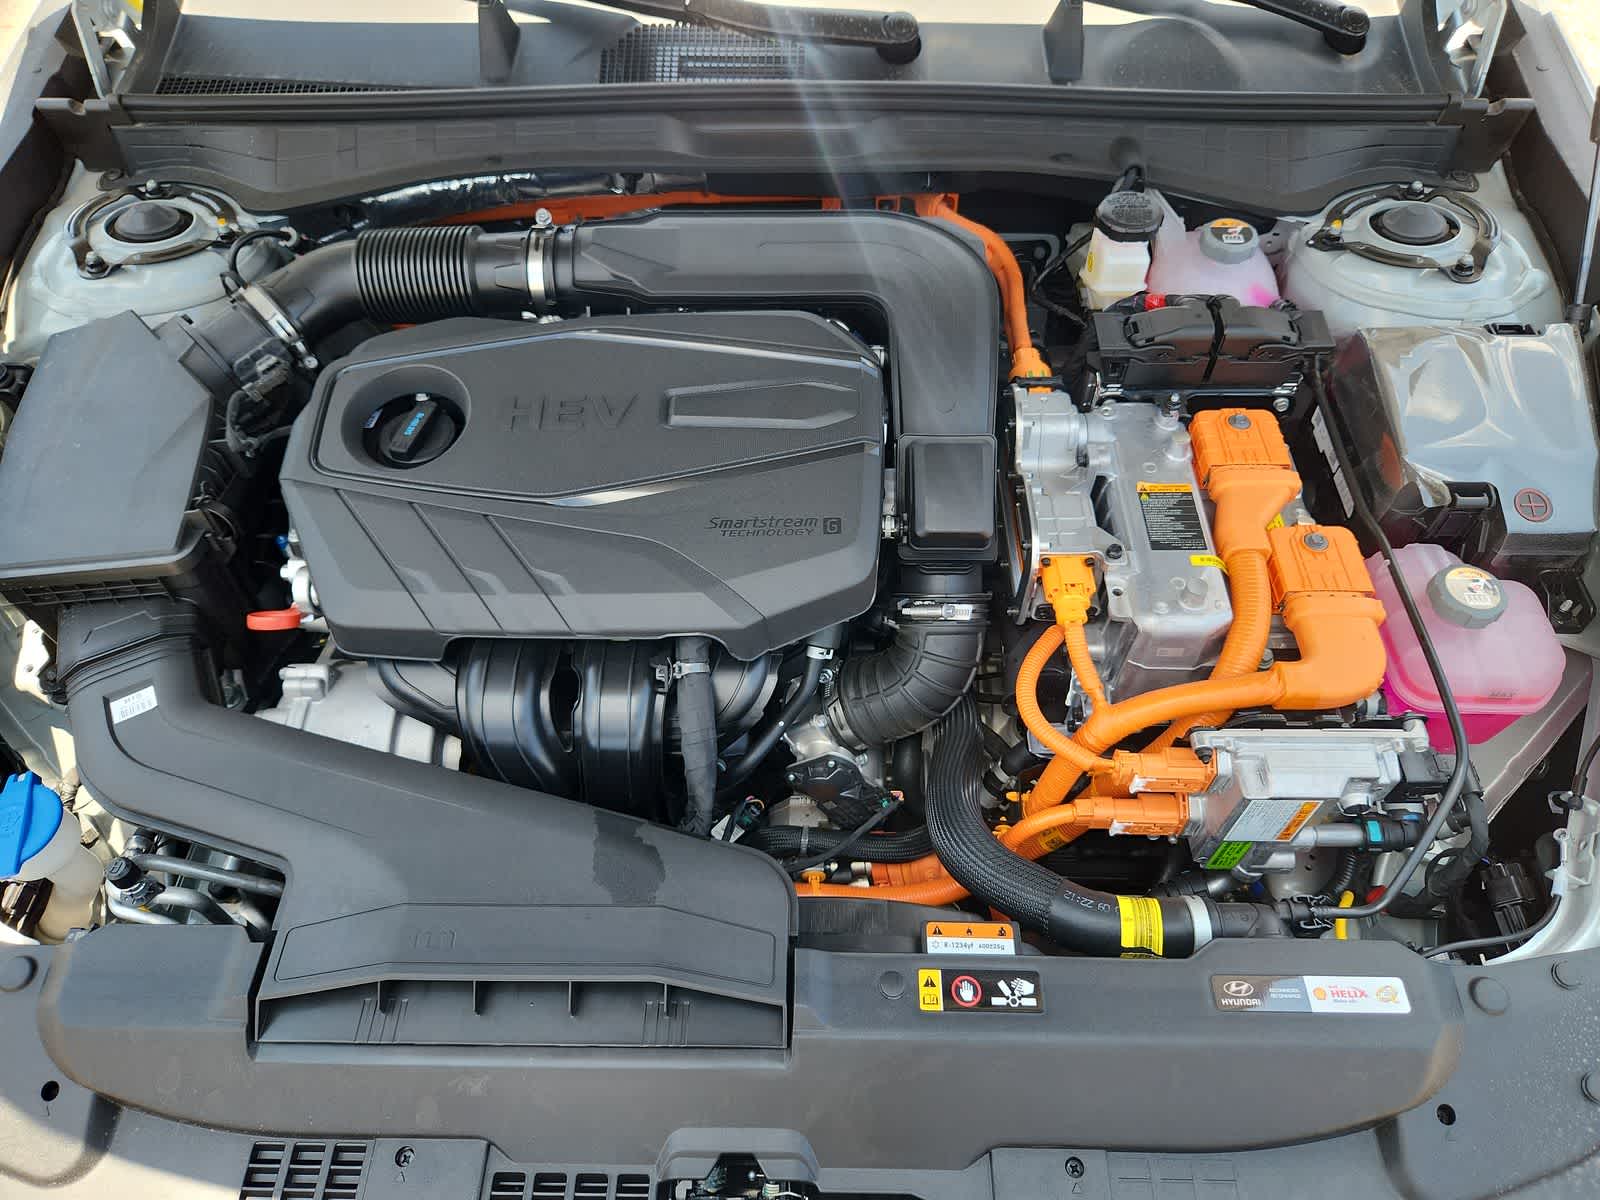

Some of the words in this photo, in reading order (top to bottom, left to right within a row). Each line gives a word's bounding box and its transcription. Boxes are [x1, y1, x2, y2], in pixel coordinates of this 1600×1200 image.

[509, 392, 640, 432] HEV
[709, 516, 818, 529] Smartstream
[720, 529, 815, 537] TECHNOLOGY
[1330, 989, 1368, 998] HELIX
[1221, 998, 1263, 1006] HYUNDAI
